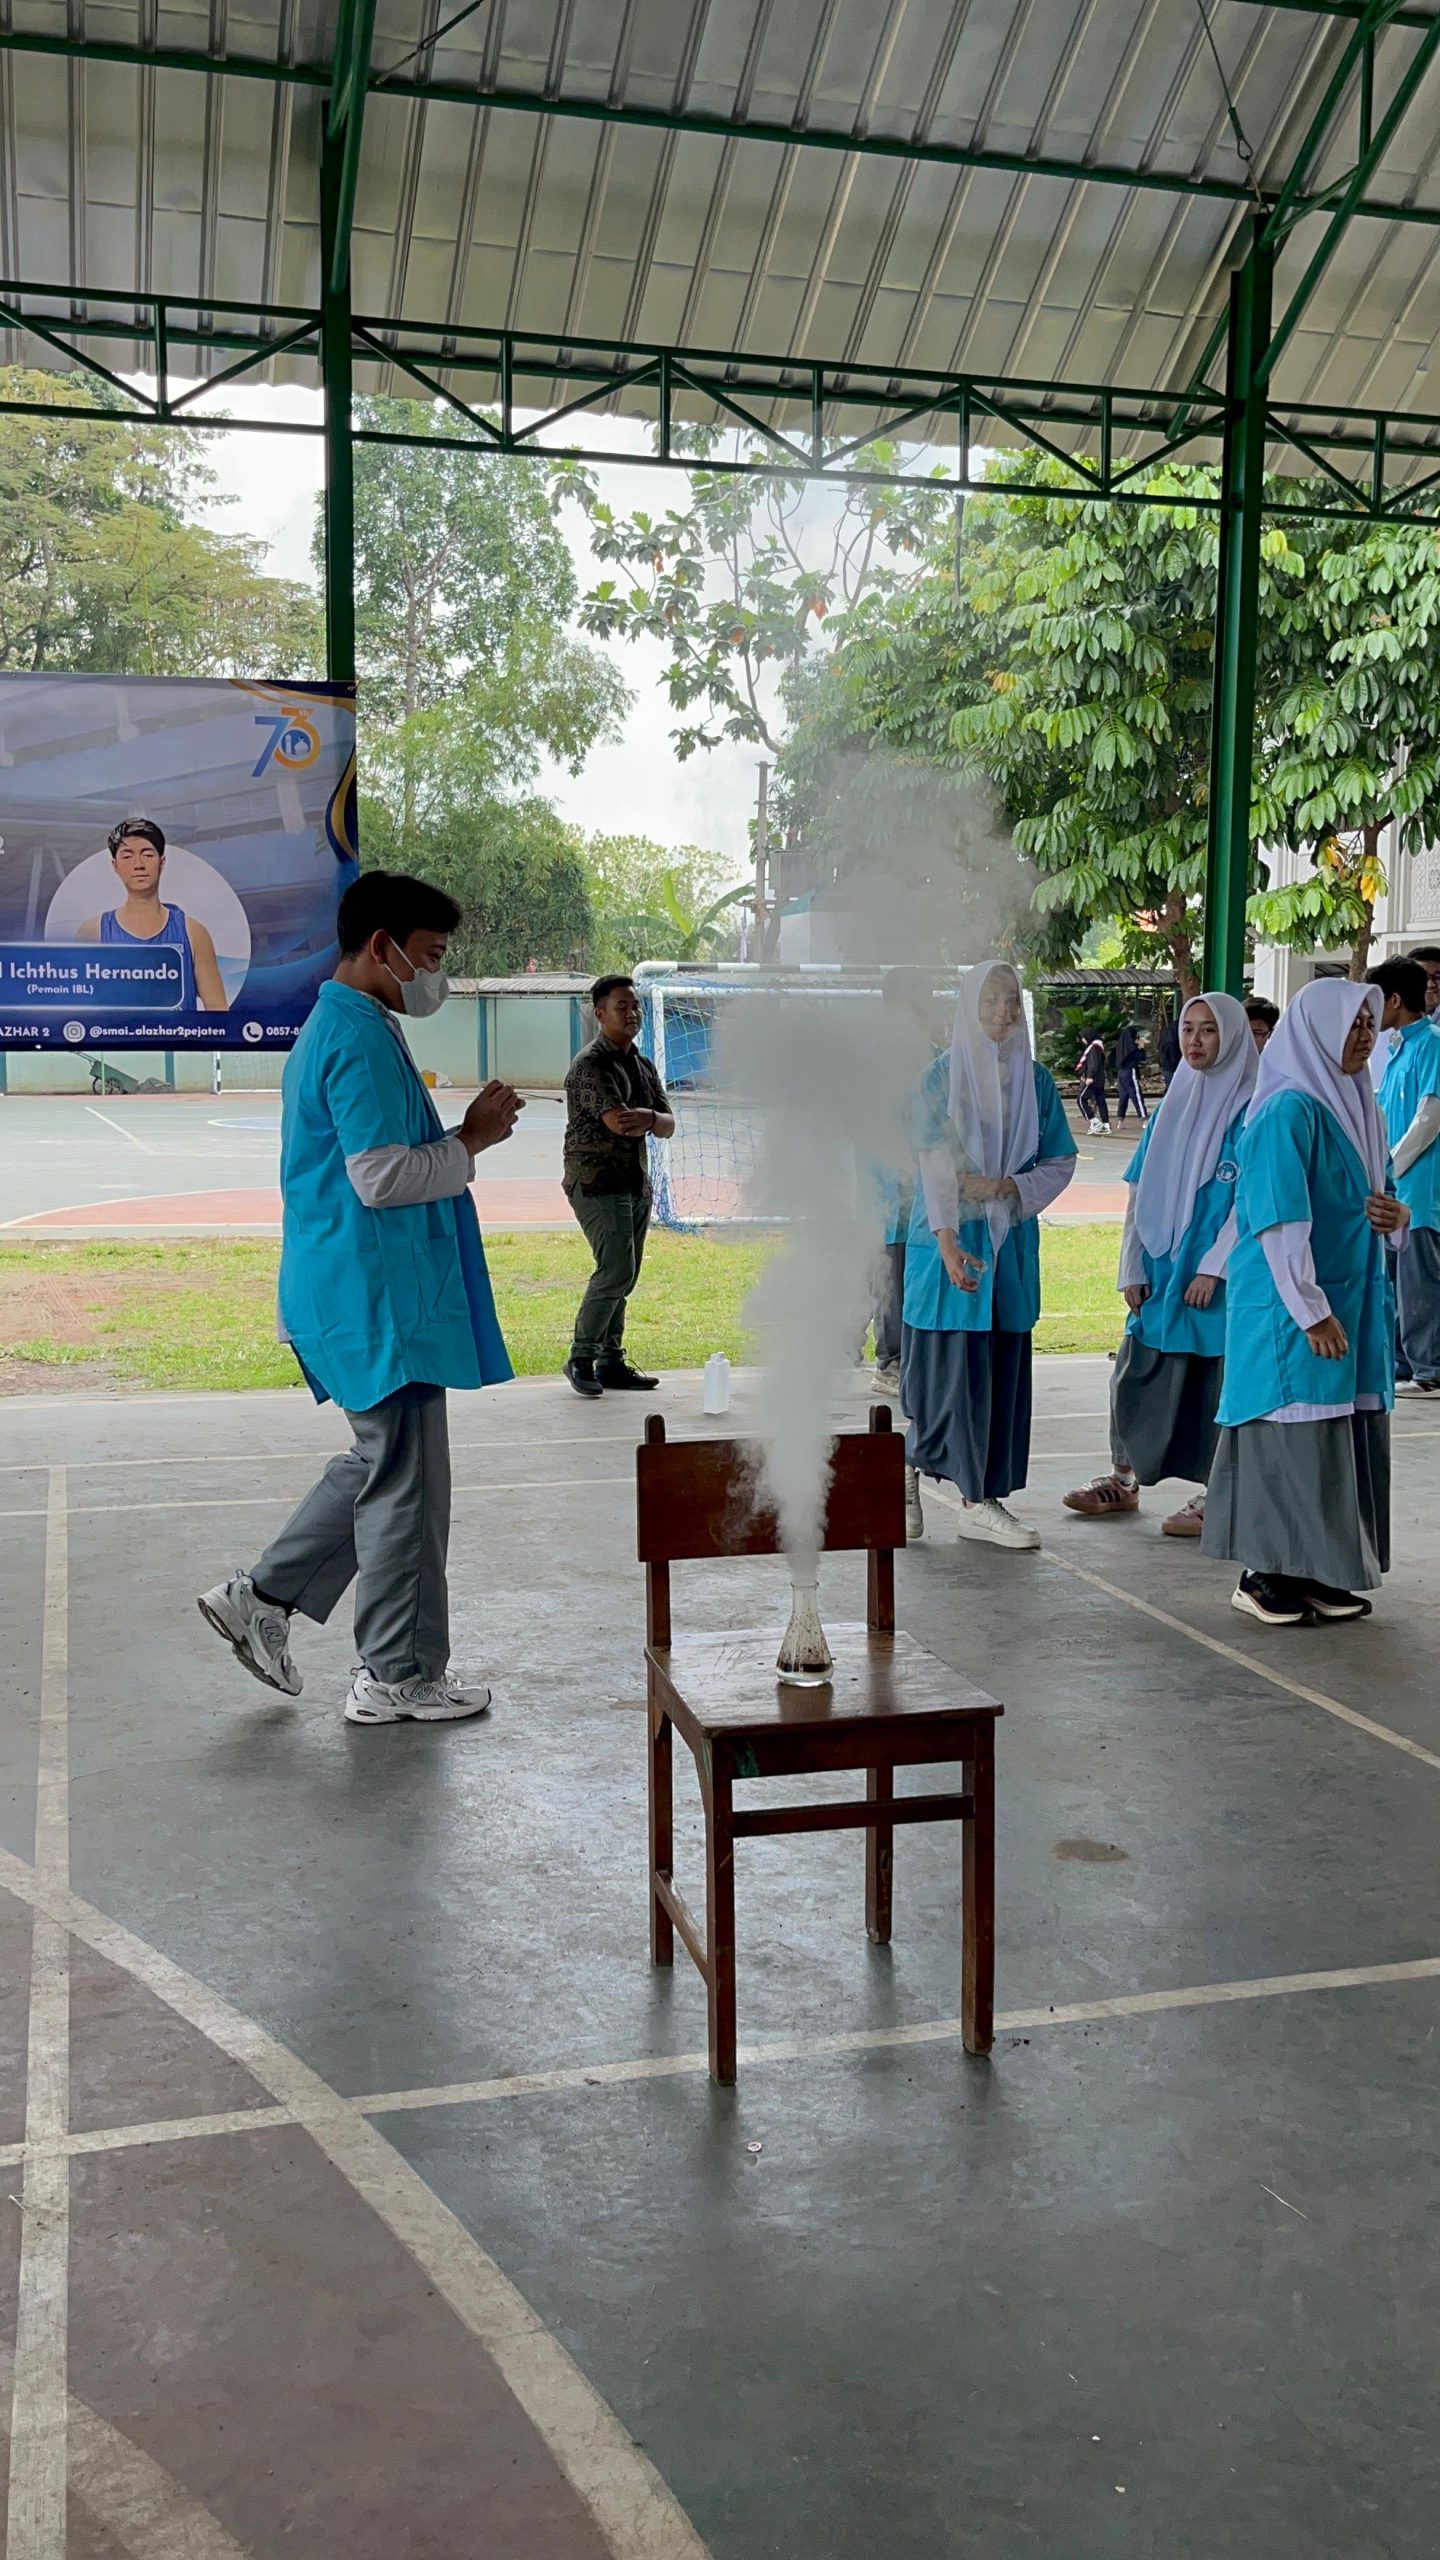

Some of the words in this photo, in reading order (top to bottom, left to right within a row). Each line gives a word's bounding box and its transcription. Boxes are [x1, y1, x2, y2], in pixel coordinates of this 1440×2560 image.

[10, 961, 79, 979] Ichthus
[85, 962, 179, 980] Hernando
[26, 984, 69, 995] (Pemain
[72, 984, 94, 995] IBL)
[42, 1027, 50, 1037] 2
[89, 1024, 226, 1038] @smai_alazhar2pejaten
[266, 1026, 302, 1036] 0857-8
